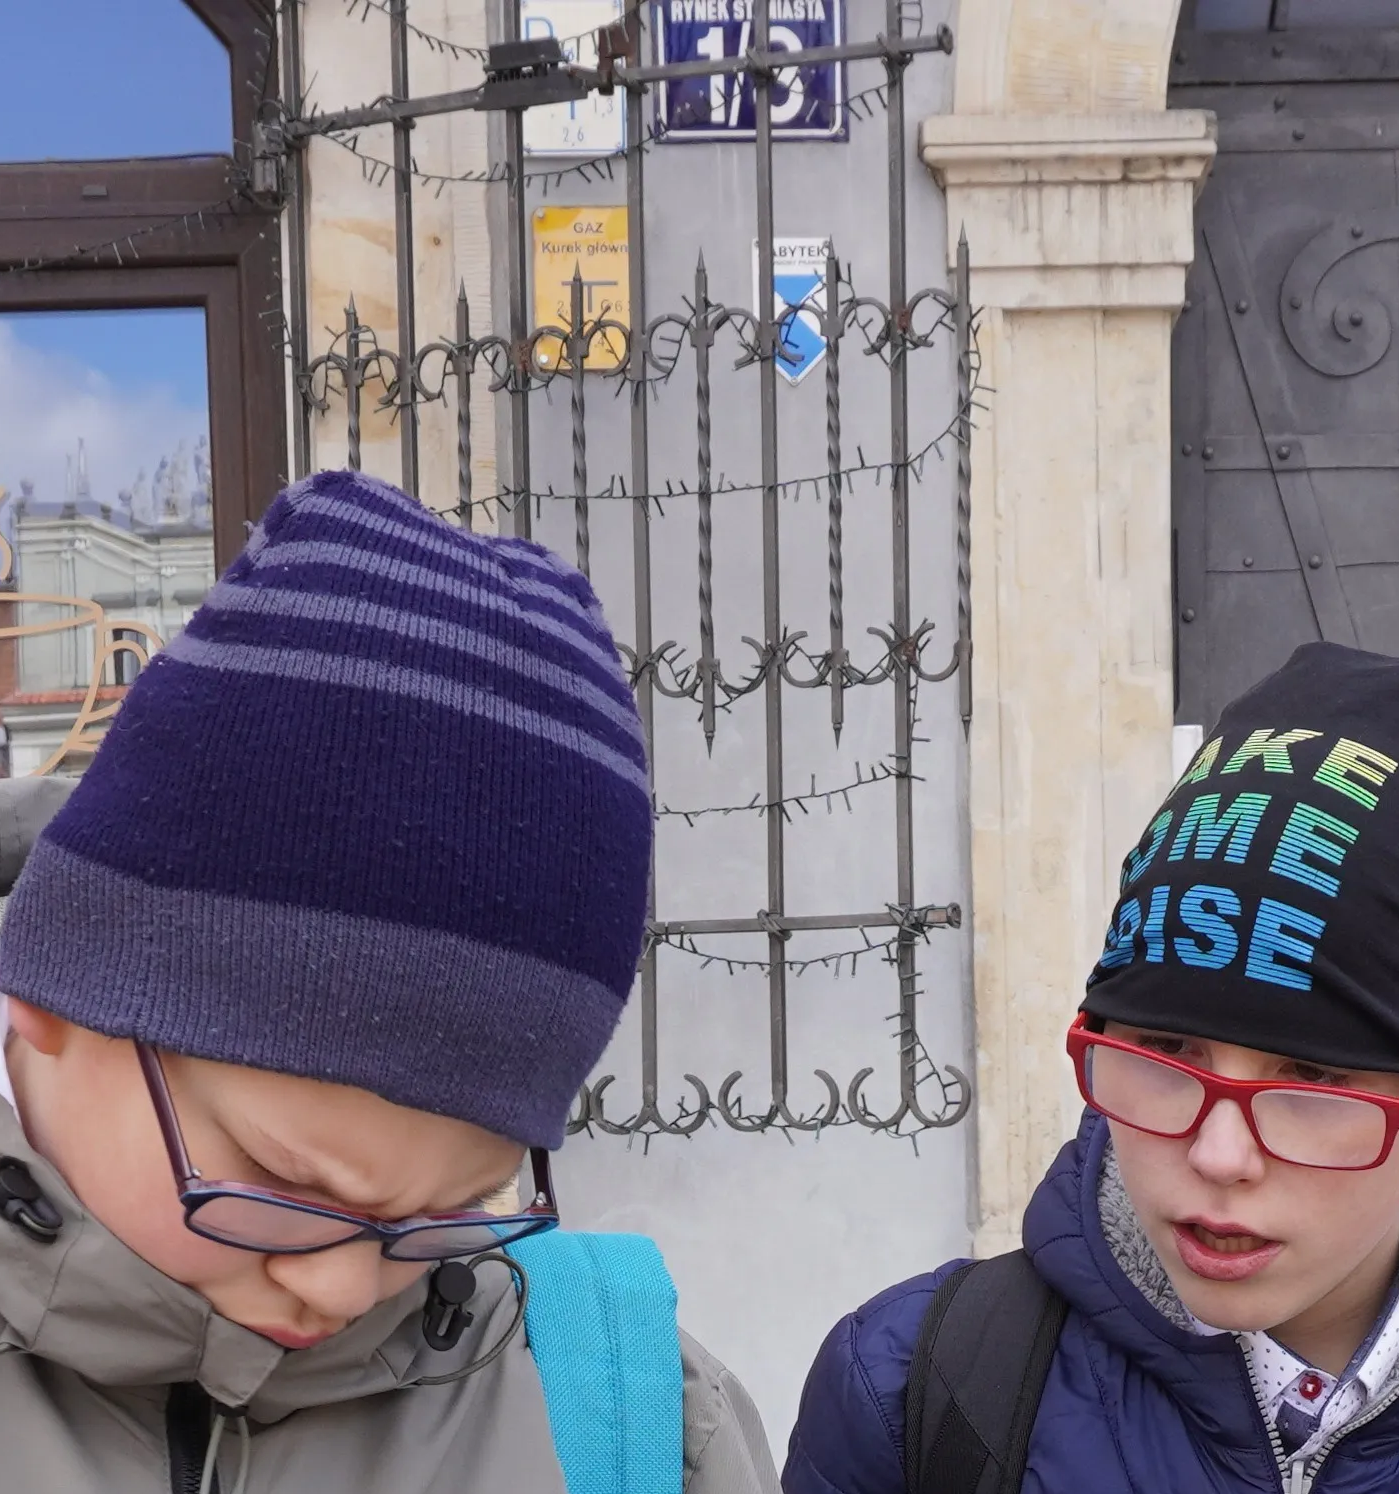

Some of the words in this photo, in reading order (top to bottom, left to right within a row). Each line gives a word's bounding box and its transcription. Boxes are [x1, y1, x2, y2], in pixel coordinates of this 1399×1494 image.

[671, 0, 729, 21] RYNEK
[573, 222, 604, 234] GAZ
[541, 242, 582, 253] Kurek
[587, 241, 630, 256] główn
[773, 245, 826, 257] BYTEK
[1174, 728, 1399, 811] AKE
[1120, 792, 1360, 898] OME
[1089, 884, 1327, 991] OISE
